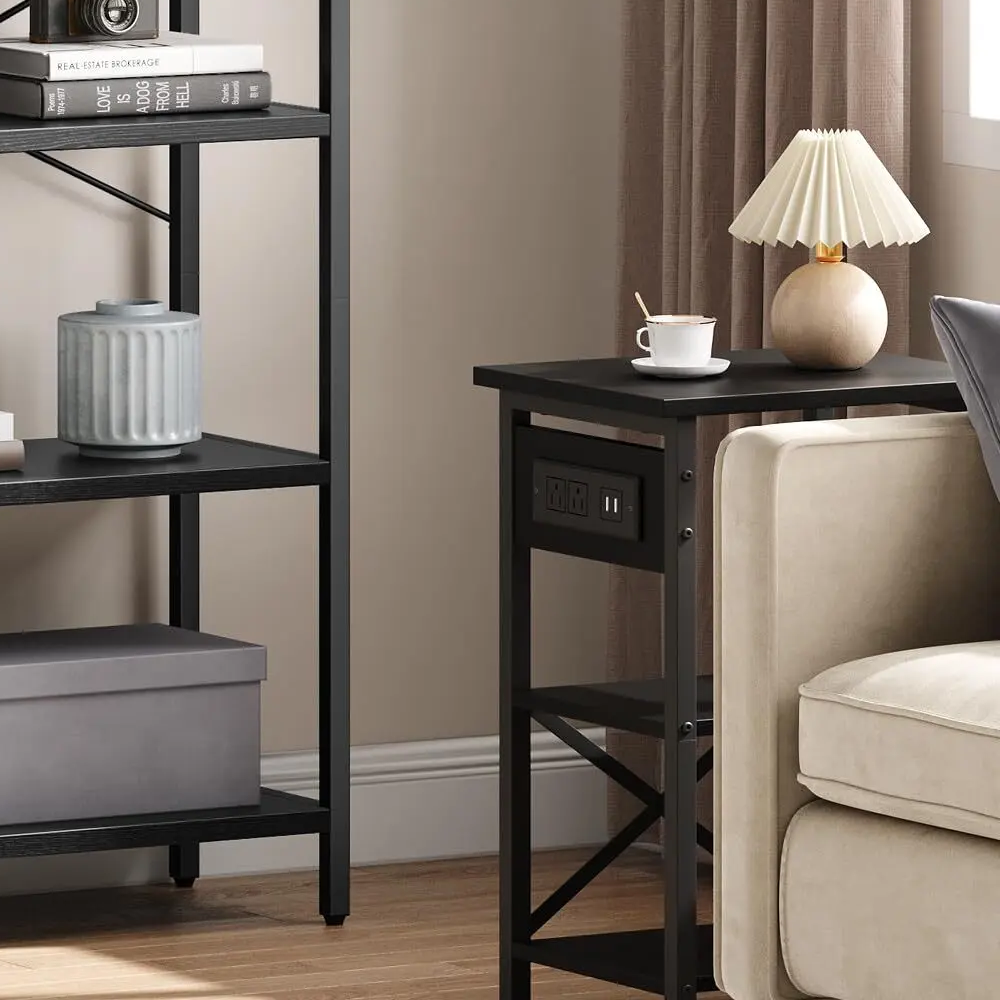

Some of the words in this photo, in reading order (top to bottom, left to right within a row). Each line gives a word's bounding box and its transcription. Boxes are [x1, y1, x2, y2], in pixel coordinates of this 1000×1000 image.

[57, 60, 109, 71] REAL-ESTATE
[111, 58, 160, 68] BROKERAGE
[96, 85, 110, 113] LOVE
[117, 93, 130, 104] IS
[156, 81, 170, 112] FROM
[176, 82, 190, 109] HELL
